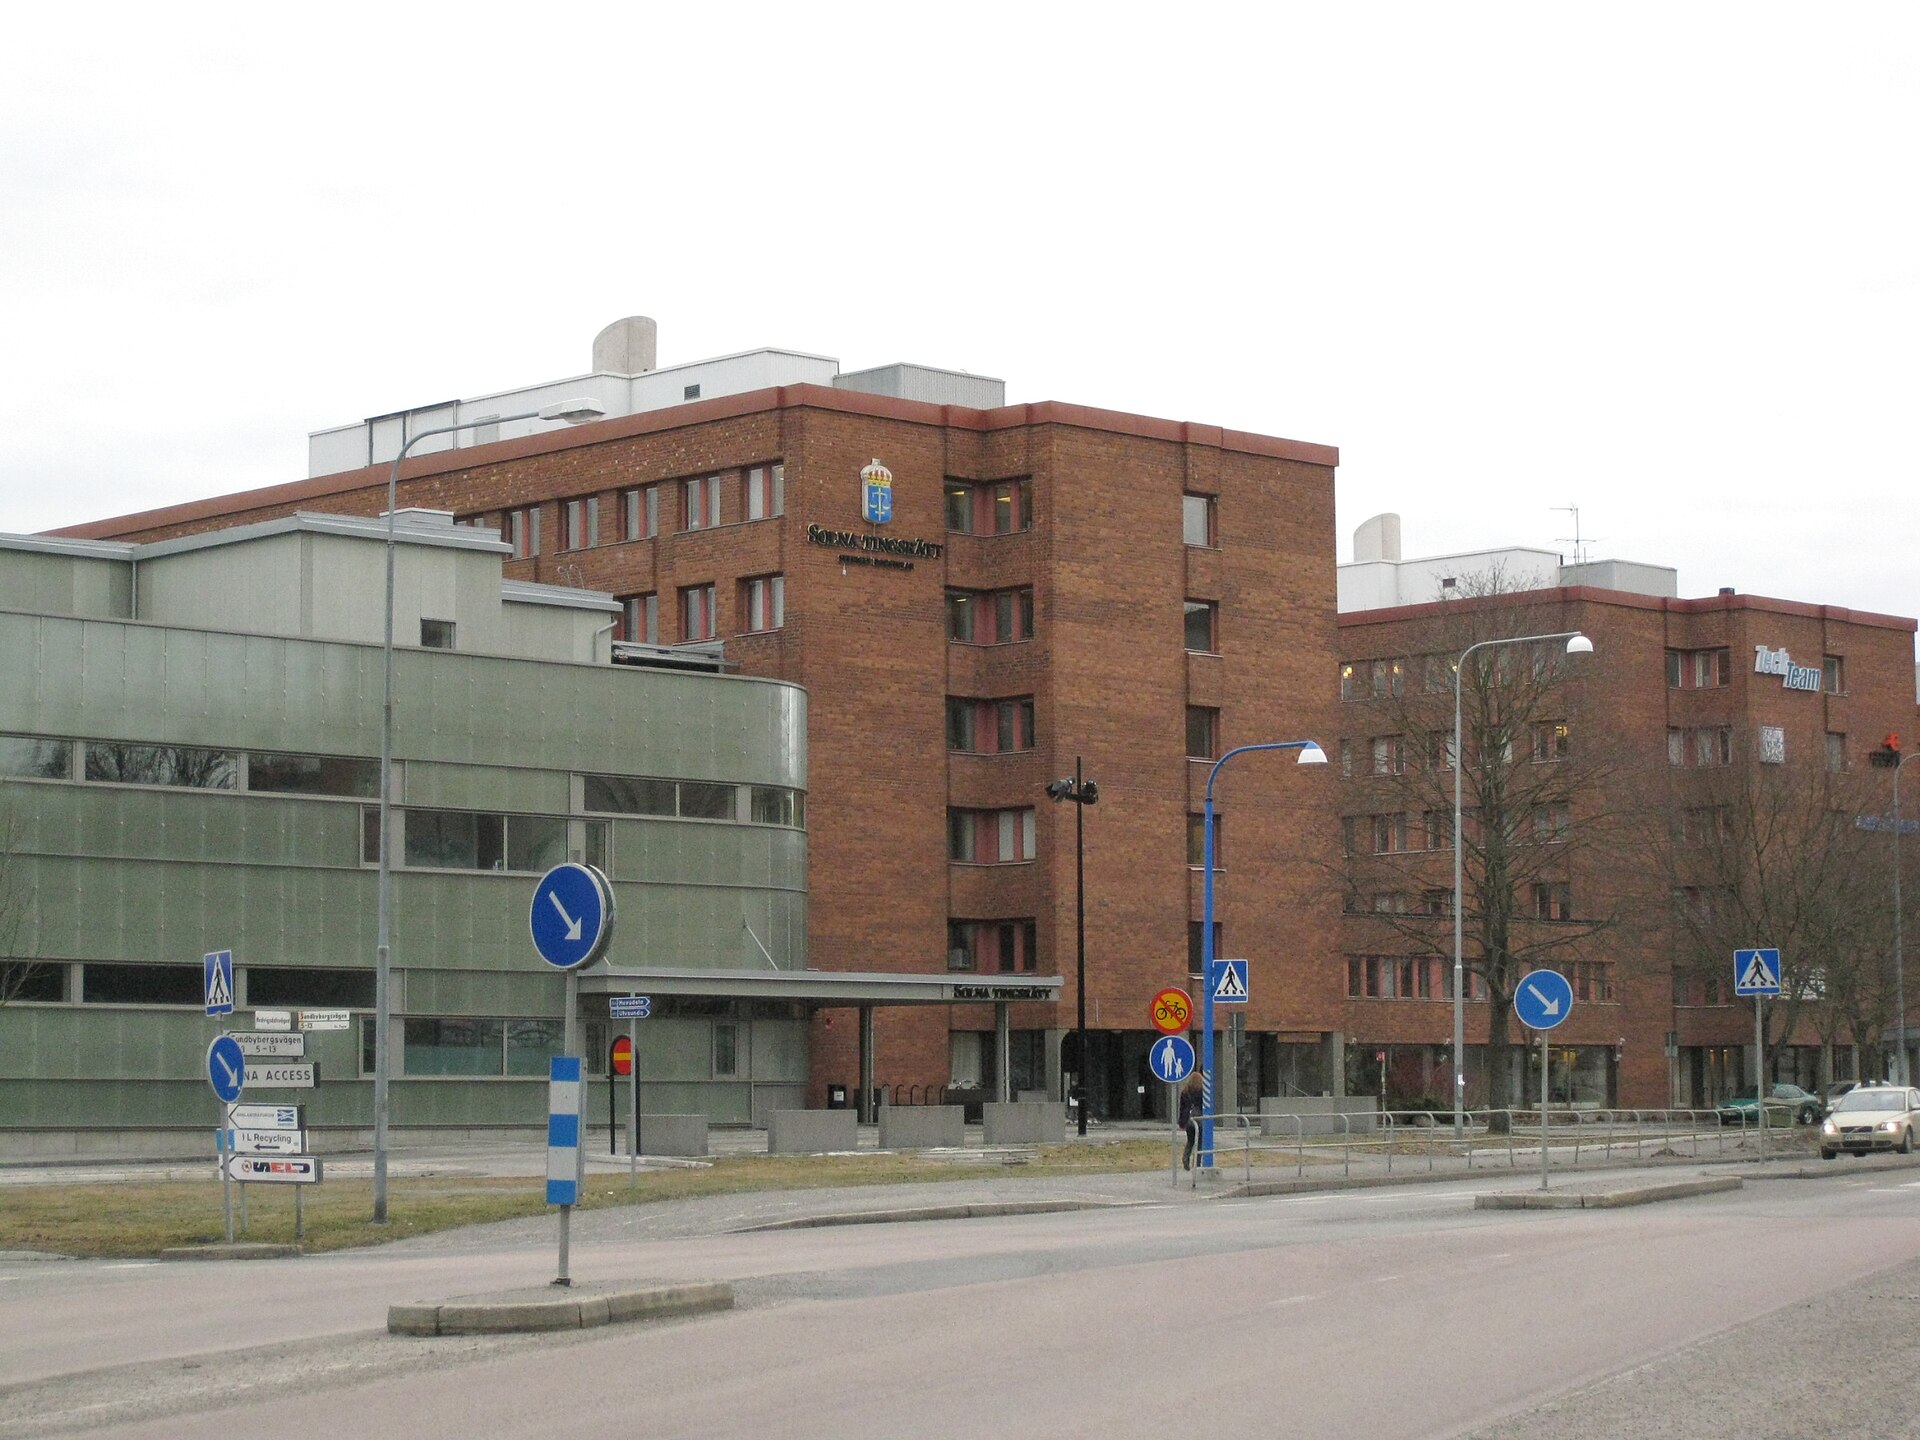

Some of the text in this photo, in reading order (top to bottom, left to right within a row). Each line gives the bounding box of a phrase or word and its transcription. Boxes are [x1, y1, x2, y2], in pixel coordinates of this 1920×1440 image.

[1786, 661, 1820, 690] Team
[266, 1070, 311, 1081] ACCESS
[254, 1133, 292, 1145] Recycling
